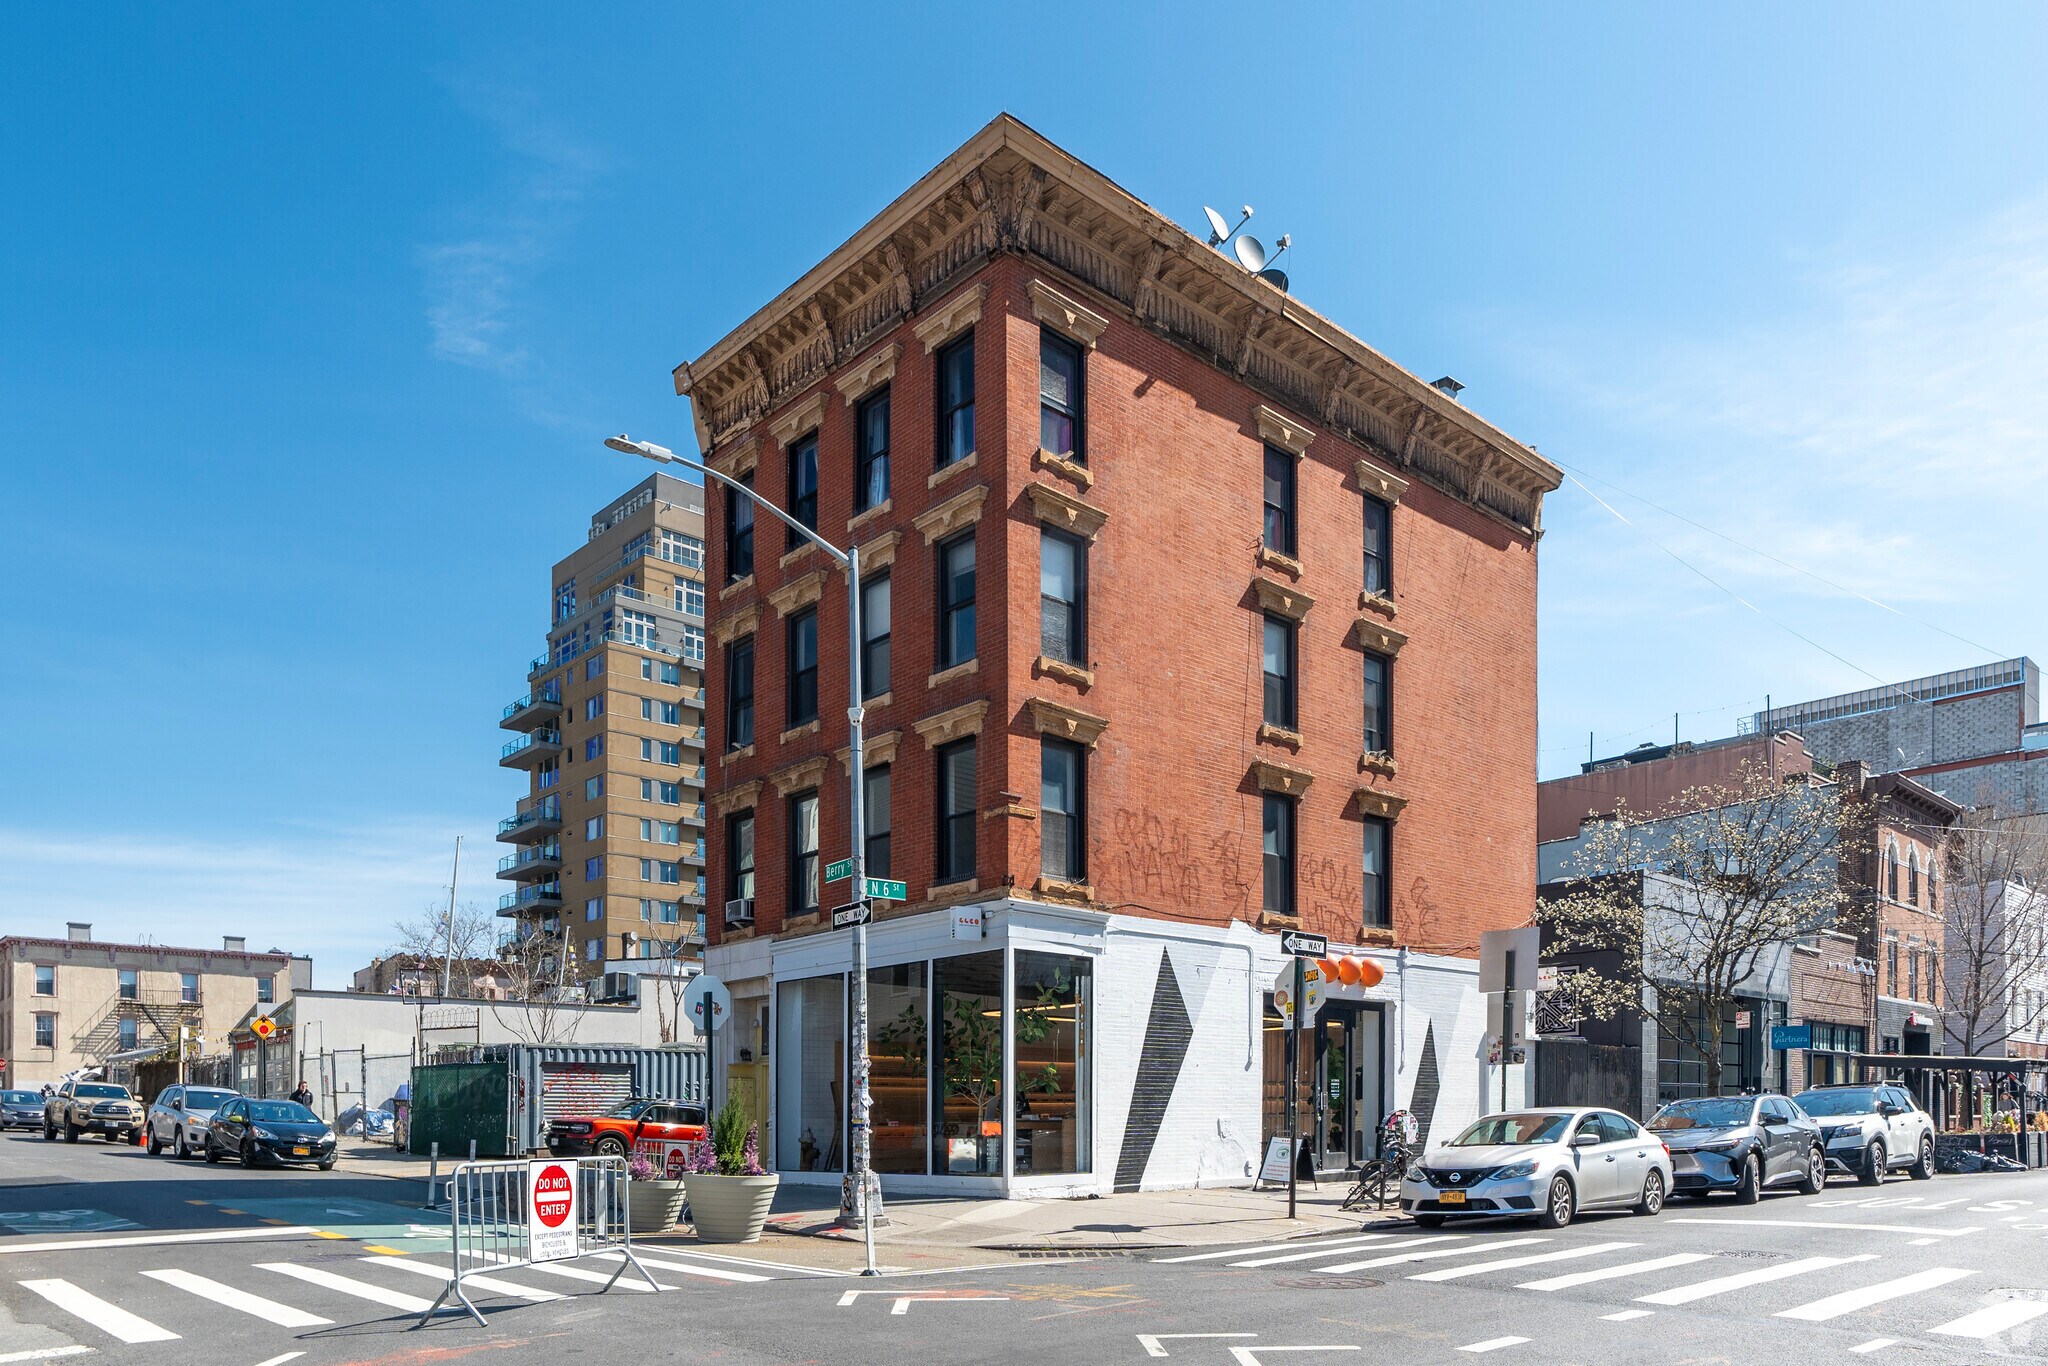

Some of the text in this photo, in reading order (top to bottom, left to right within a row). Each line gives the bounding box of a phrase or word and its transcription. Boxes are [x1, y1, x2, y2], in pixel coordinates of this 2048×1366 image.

[826, 863, 844, 878] Berry
[871, 881, 899, 896] N 6 St
[837, 908, 866, 924] ONE WAY
[1289, 939, 1321, 951] ONE WAY
[1774, 1031, 1807, 1044] Partners
[538, 1177, 568, 1190] DO NOT
[540, 1203, 566, 1217] ENTER
[534, 1230, 573, 1241] EXCEPT PEDESTRIANS
